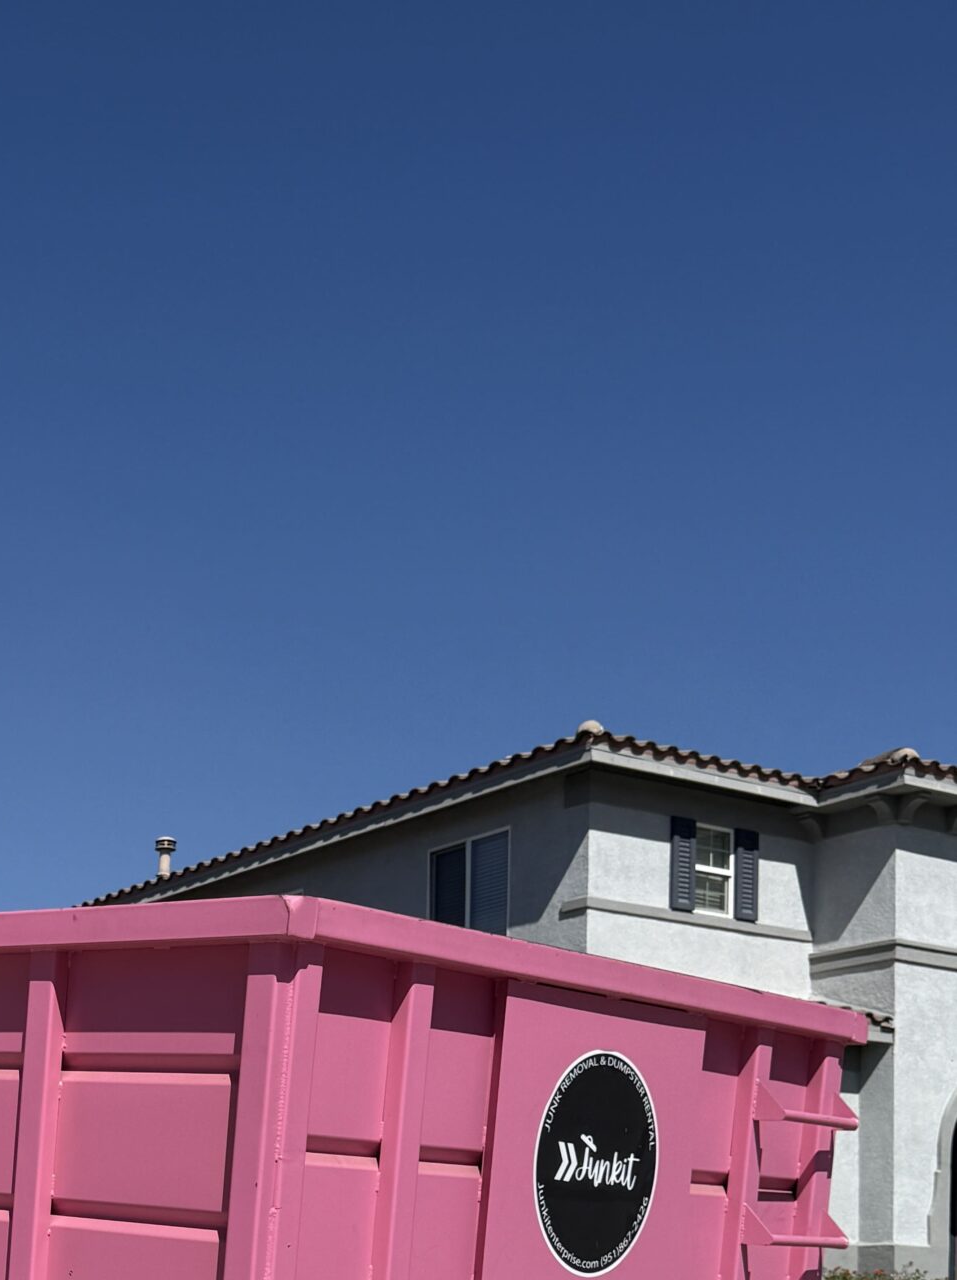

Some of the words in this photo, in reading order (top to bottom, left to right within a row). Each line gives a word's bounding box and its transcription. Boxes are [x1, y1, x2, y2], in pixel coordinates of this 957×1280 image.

[544, 1093, 563, 1133] JUNK
[560, 1058, 599, 1093] REMOVAL
[599, 1056, 607, 1066] &
[607, 1056, 645, 1098] DUMPSTER
[642, 1095, 656, 1151] RENTAL
[575, 1147, 641, 1191] Junkit
[600, 1196, 649, 1268] (951)867-2426
